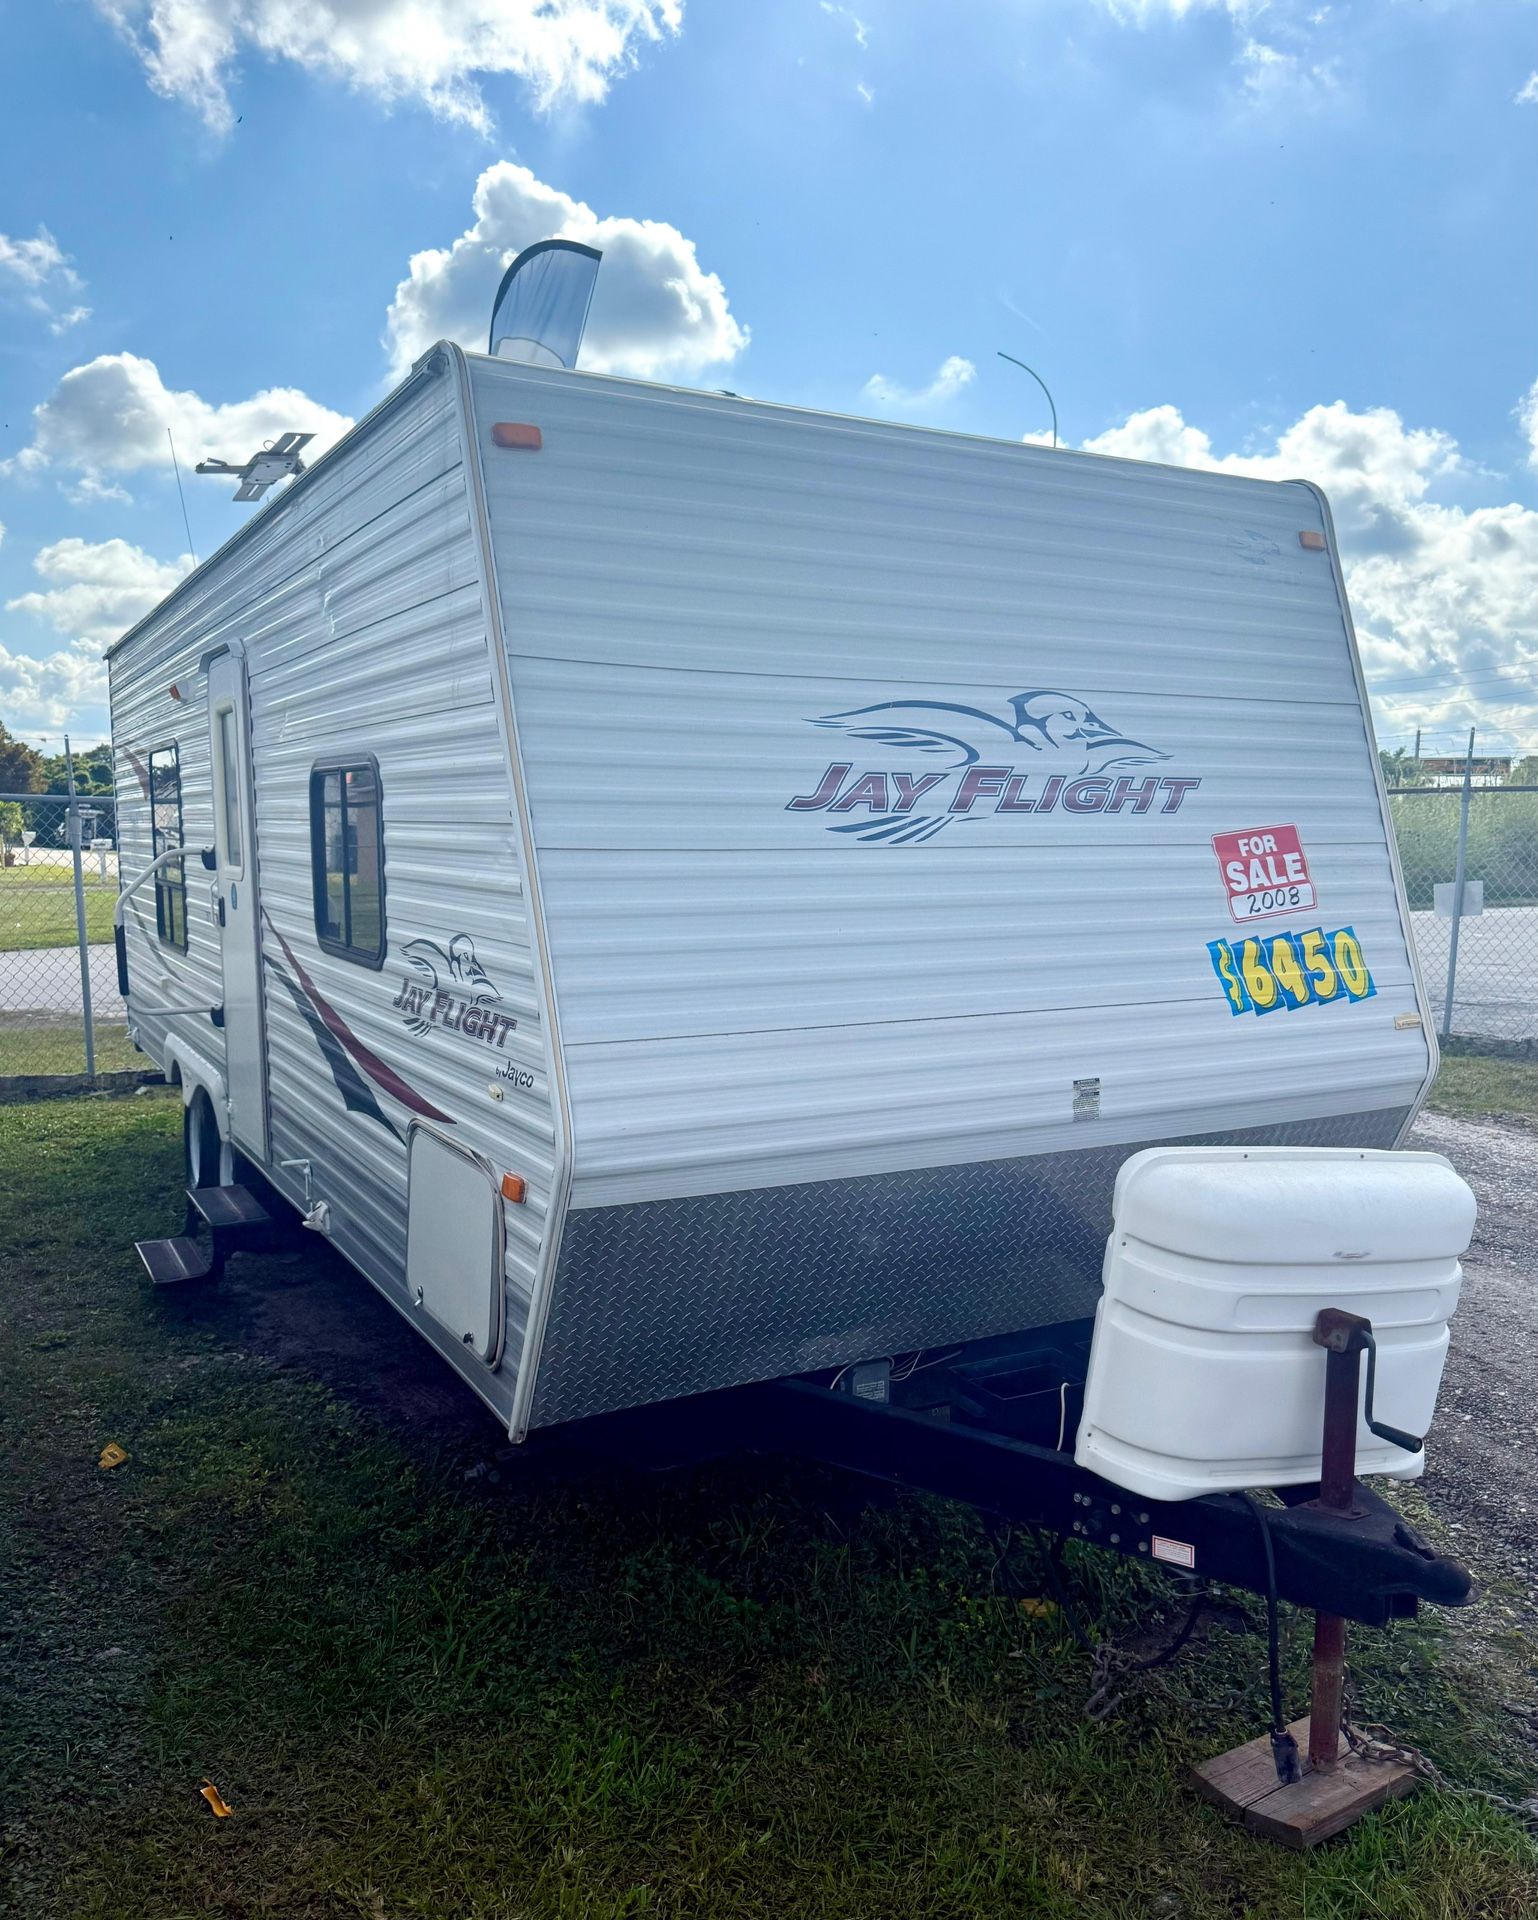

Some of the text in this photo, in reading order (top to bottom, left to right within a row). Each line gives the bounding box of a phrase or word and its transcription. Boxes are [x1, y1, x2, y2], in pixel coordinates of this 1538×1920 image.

[785, 762, 1202, 814] JAY FLIGHT
[1237, 834, 1278, 857] FOR
[1226, 852, 1306, 892] SALE
[1247, 886, 1300, 914] 2008
[1217, 931, 1368, 1011] $6450
[393, 978, 517, 1047] JAY FLIGHT
[502, 1060, 534, 1088] Jayco
